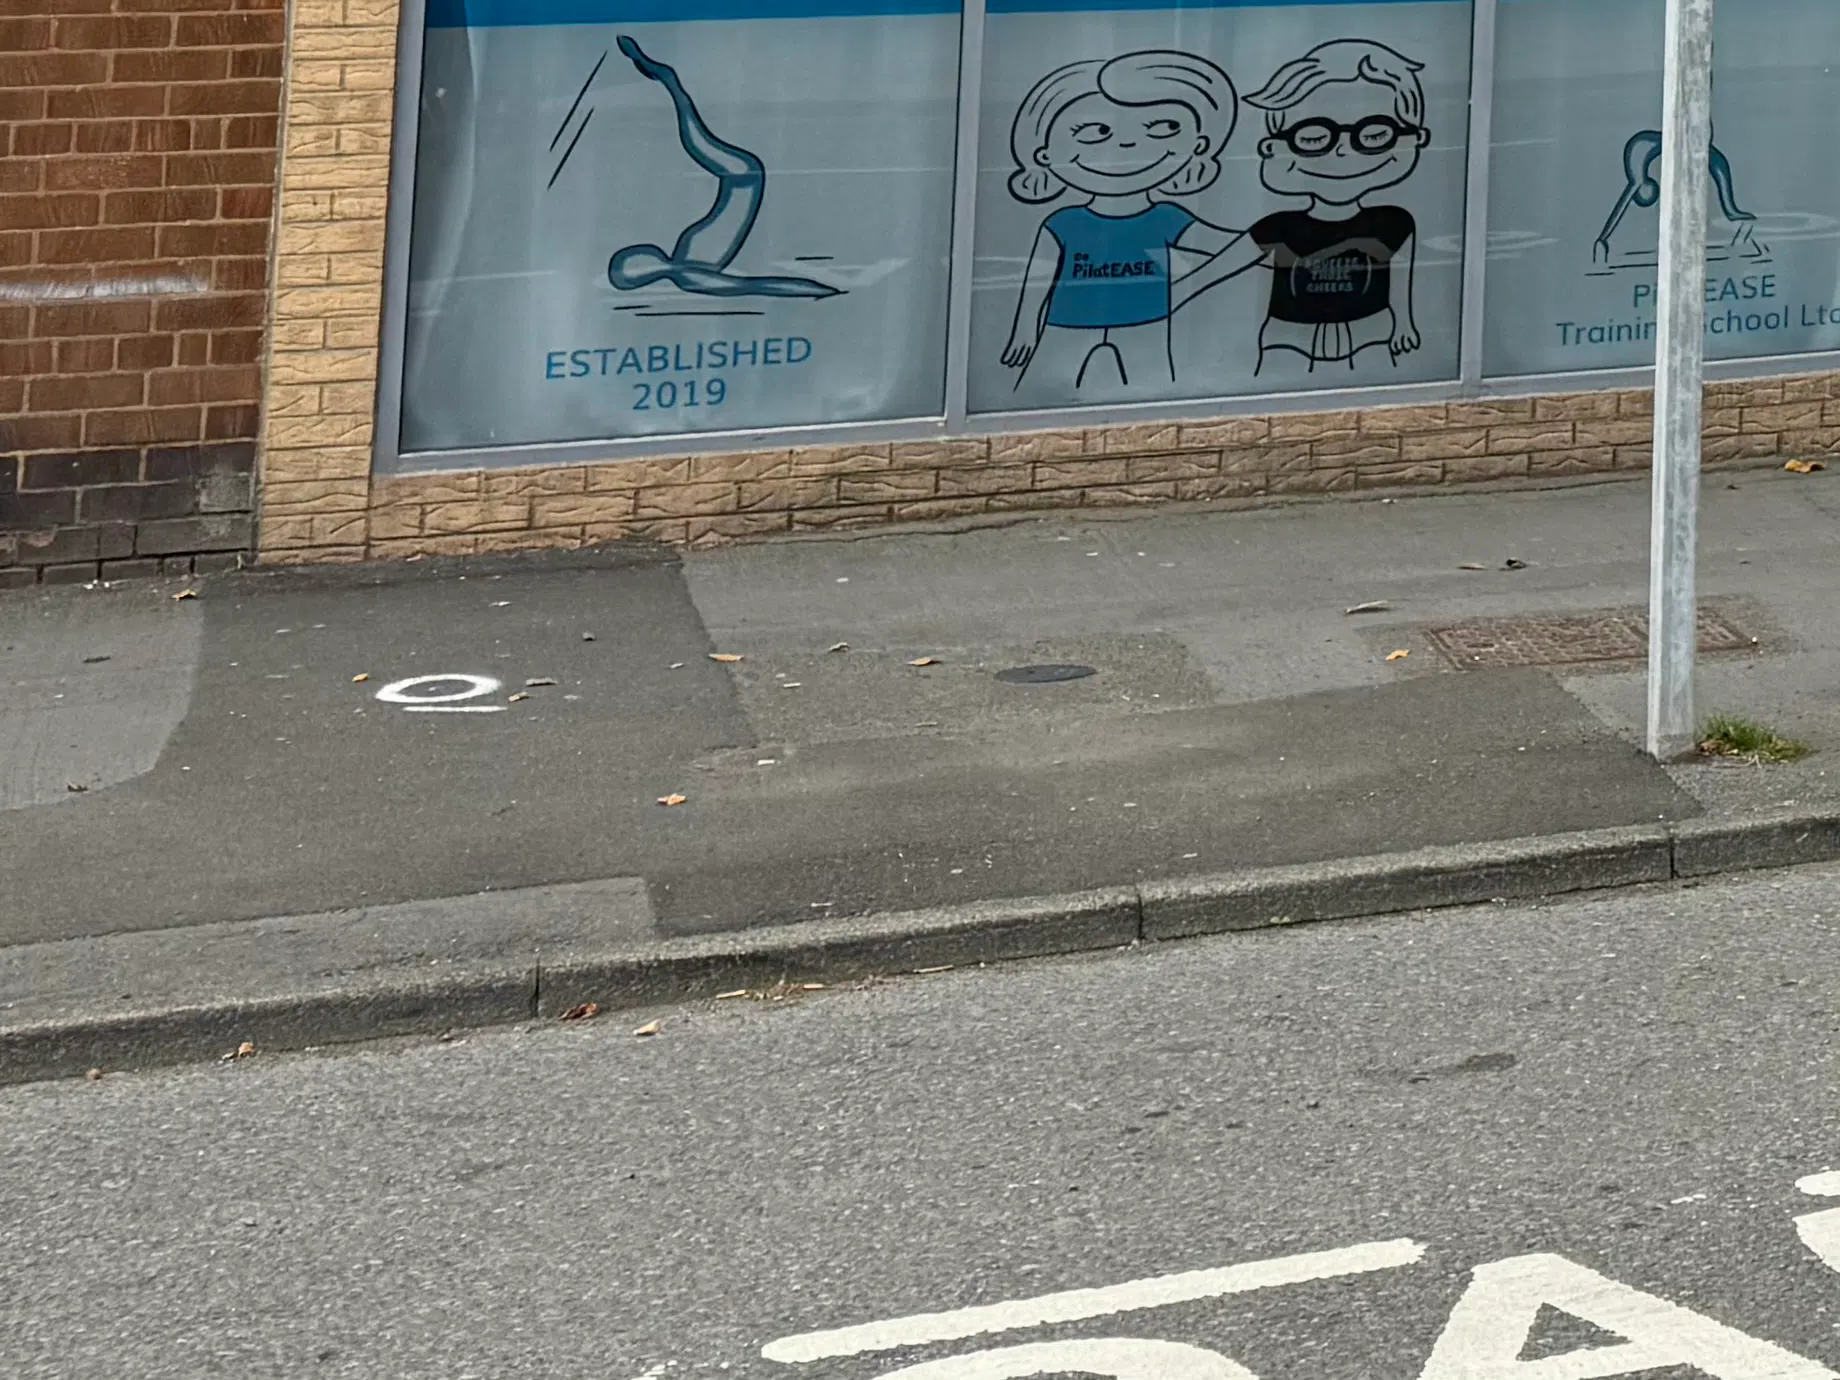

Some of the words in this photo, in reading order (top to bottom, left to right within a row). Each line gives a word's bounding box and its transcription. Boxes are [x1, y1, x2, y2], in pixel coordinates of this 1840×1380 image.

[1073, 260, 1155, 279] PilatEASE
[1632, 274, 1777, 308] PiEASE
[1556, 316, 1657, 346] Trainin
[1702, 305, 1790, 336] chool
[545, 336, 813, 379] ESTABLISHED
[632, 378, 727, 411] 2019
